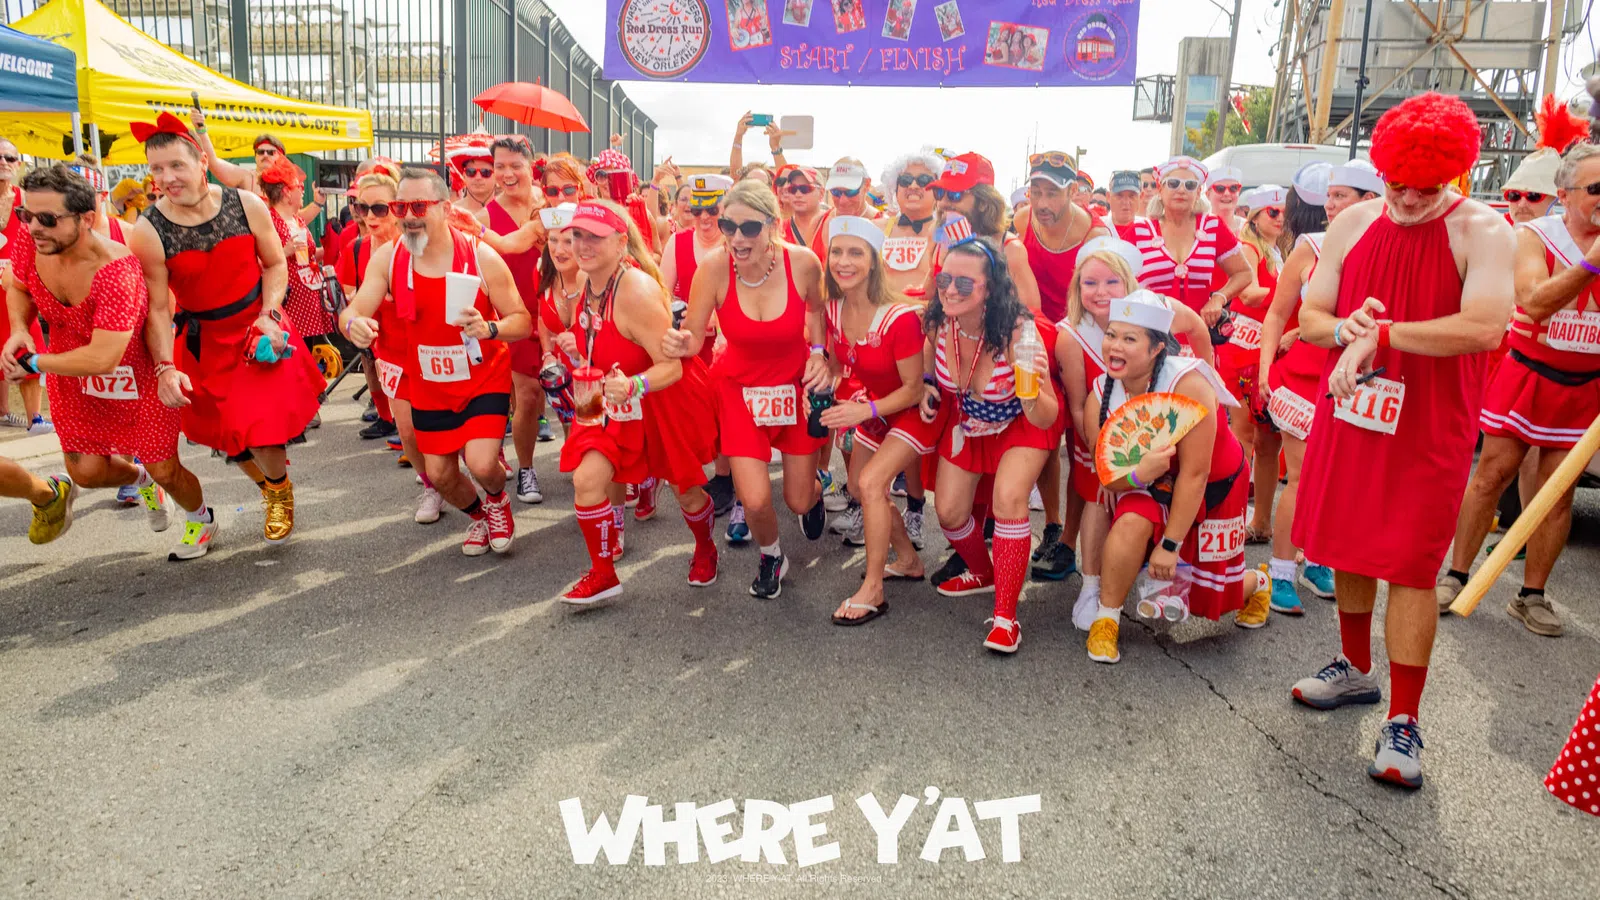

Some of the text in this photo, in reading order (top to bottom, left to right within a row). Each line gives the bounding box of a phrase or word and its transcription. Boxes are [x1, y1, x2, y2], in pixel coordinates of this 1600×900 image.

[626, 24, 703, 34] Red Dress Run
[630, 46, 697, 70] NEW ORLEANS
[780, 43, 855, 73] START
[880, 45, 967, 75] FINISH
[430, 357, 455, 375] 69
[1382, 385, 1400, 394] RUN
[747, 396, 795, 418] 1268
